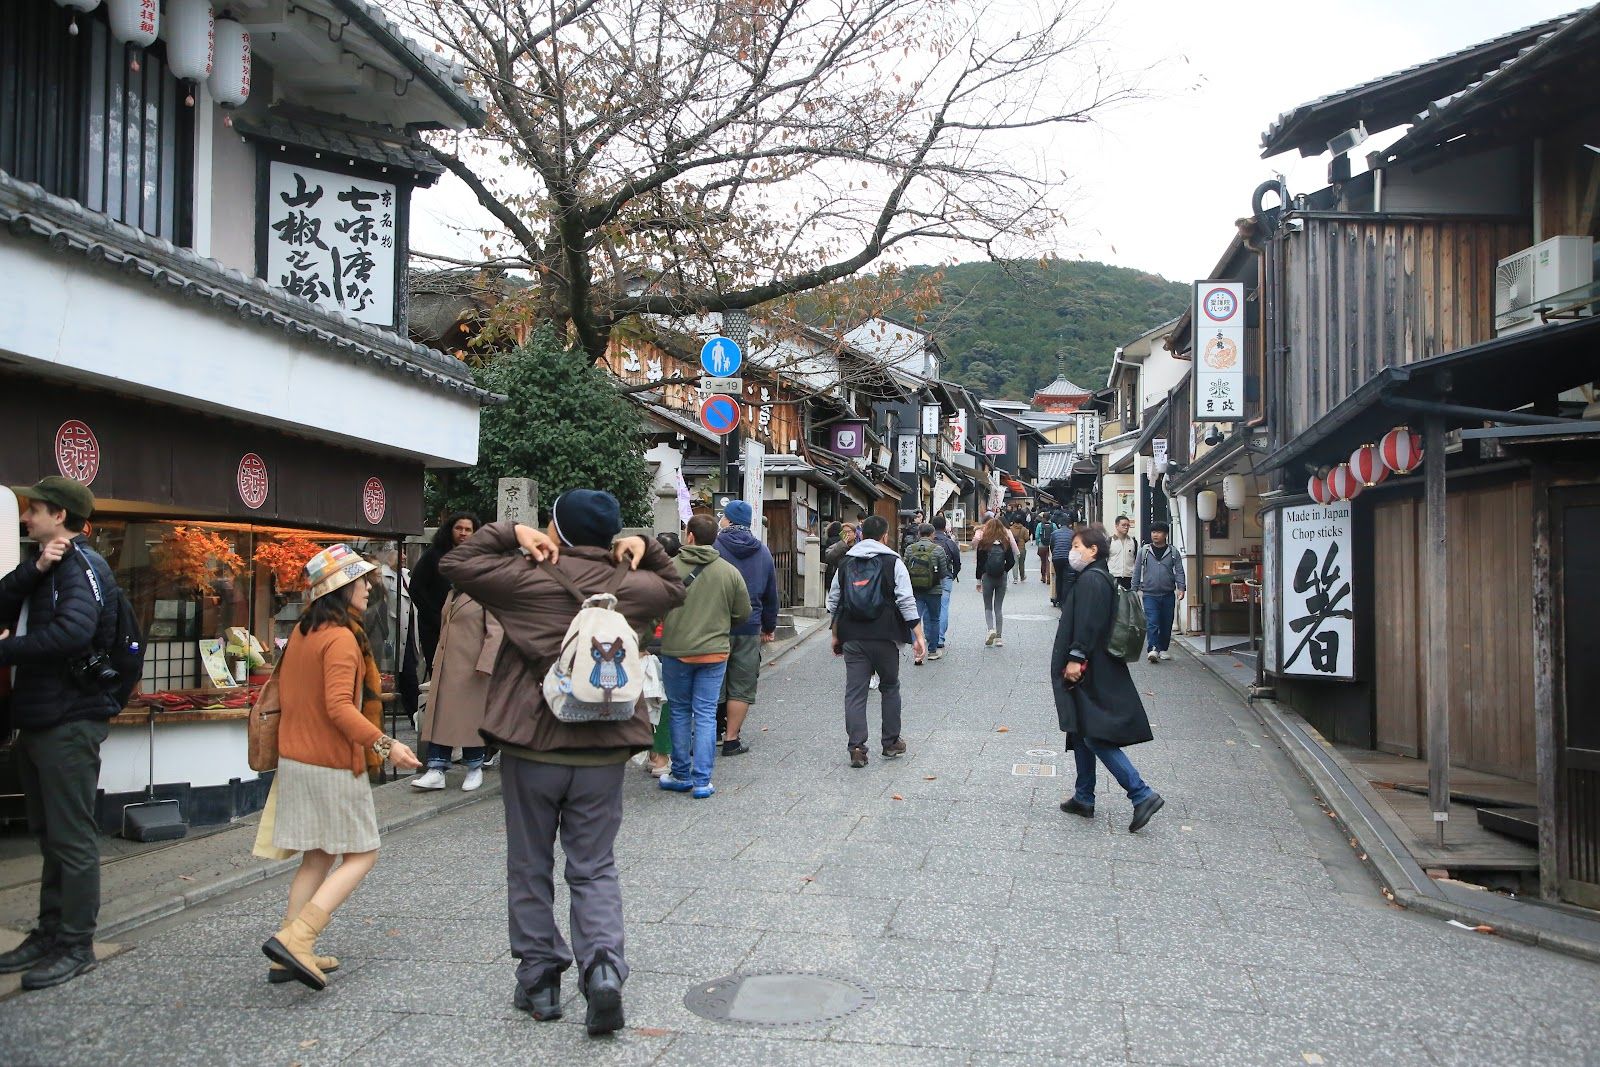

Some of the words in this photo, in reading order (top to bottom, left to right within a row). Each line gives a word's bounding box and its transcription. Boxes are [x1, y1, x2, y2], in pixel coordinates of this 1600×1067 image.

[379, 189, 393, 249] 京名物
[1206, 398, 1235, 412] 豆政
[1286, 510, 1310, 523] Made
[1311, 508, 1321, 521] in
[1322, 507, 1350, 520] Japan
[1291, 527, 1316, 542] Chop
[1317, 525, 1343, 539] sticks
[1283, 540, 1353, 673] 箸
